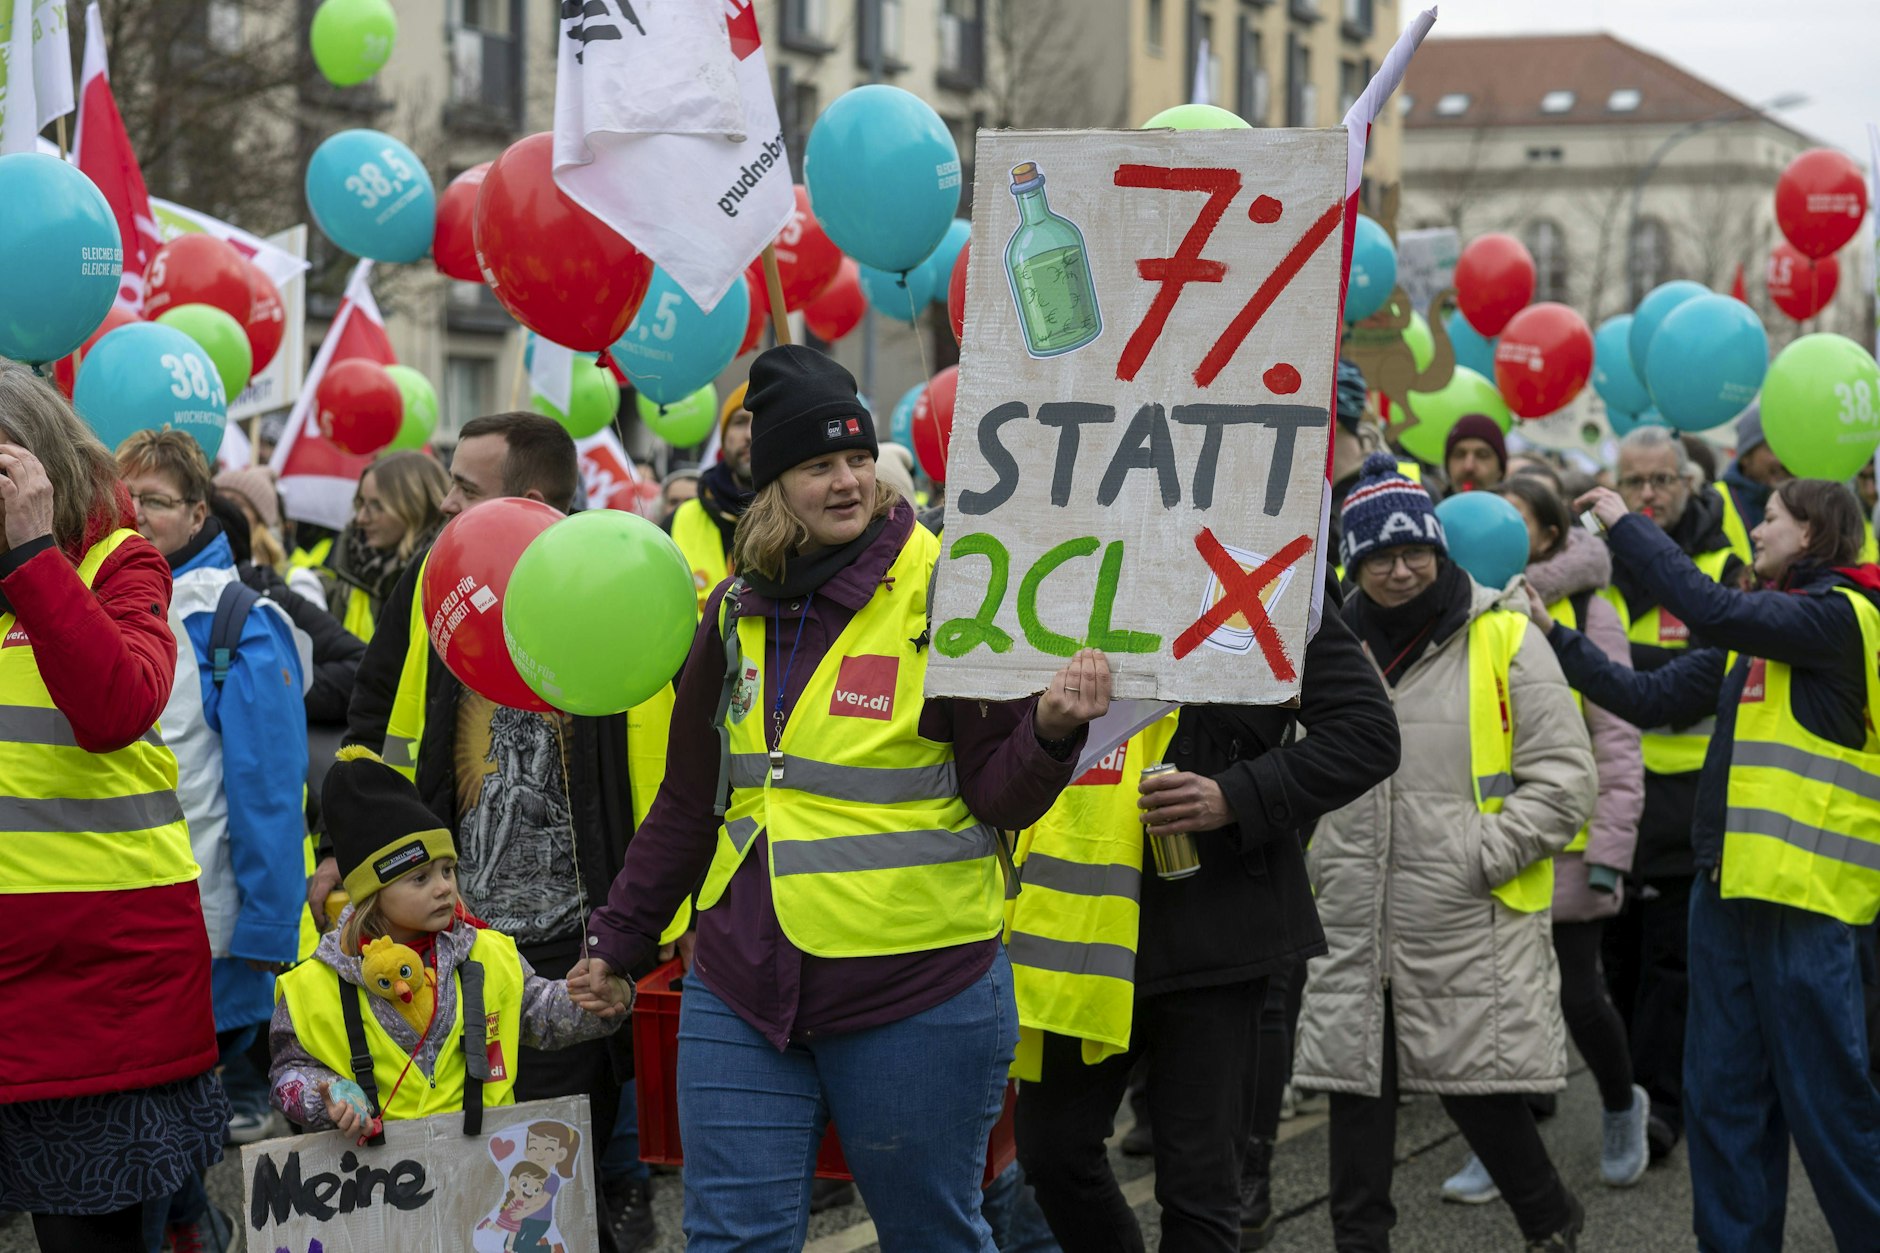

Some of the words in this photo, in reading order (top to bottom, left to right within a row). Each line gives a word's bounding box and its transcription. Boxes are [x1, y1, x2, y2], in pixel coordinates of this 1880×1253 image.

[345, 148, 411, 209] 38,5
[82, 247, 113, 260] GLEICHES
[82, 262, 110, 276] GLEICHE
[957, 401, 1329, 516] STATT
[440, 590, 459, 616] GELD
[456, 575, 477, 598] FÜR
[478, 596, 495, 609] ver.di
[446, 600, 471, 633] ARBEIT
[836, 690, 890, 712] ver.di
[251, 1151, 437, 1231] Meine
